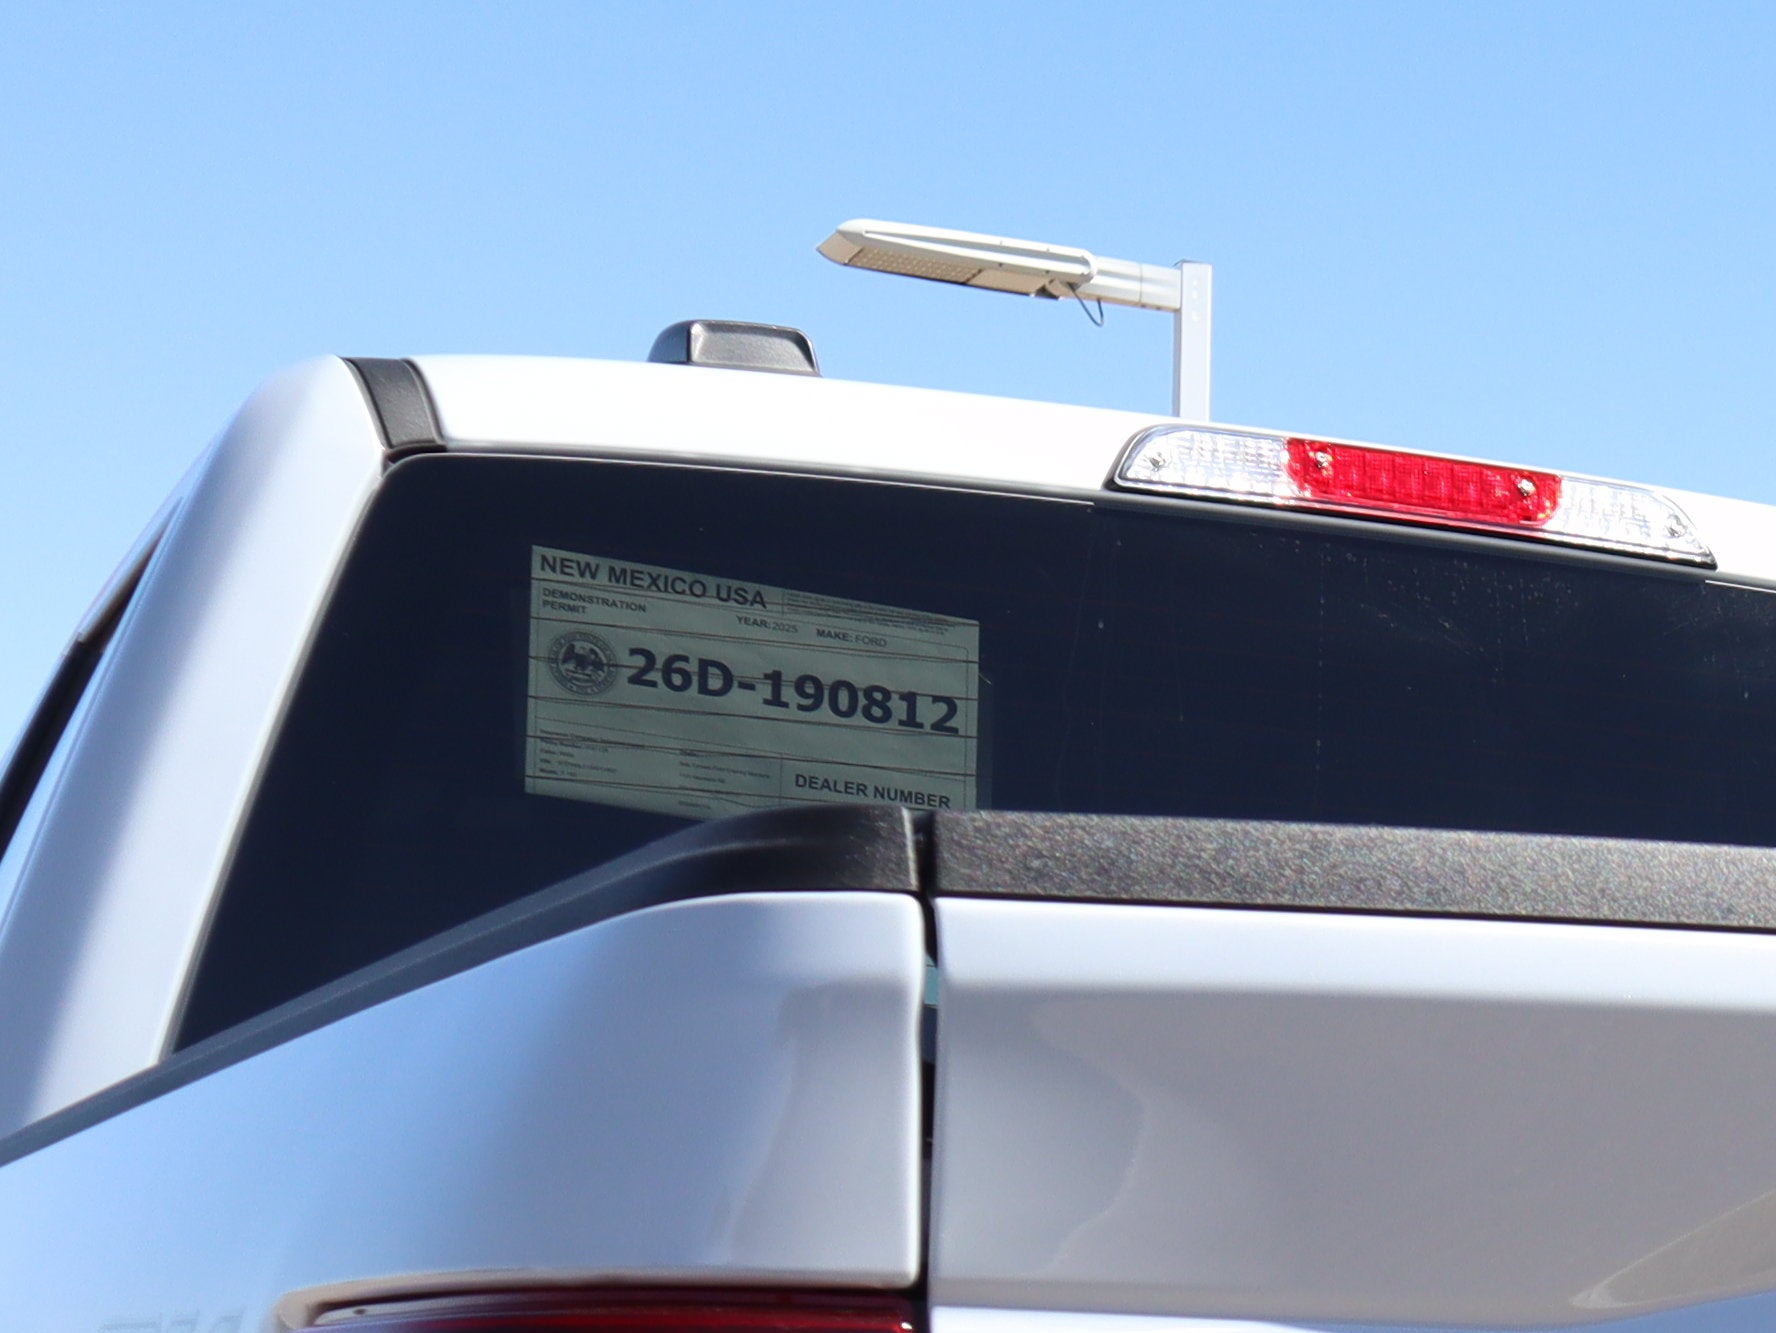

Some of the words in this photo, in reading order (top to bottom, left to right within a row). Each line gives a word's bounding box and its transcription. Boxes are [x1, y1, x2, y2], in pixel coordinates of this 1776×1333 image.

[539, 553, 600, 581] NEW
[607, 565, 708, 599] MEXICO
[716, 582, 768, 610] USA
[542, 587, 647, 613] DEMONSTRATION
[542, 600, 588, 616] PERMIT
[736, 614, 771, 631] YEAR:
[771, 621, 799, 635] 2025
[816, 627, 853, 645] MAKE:
[854, 633, 888, 649] FORD
[626, 646, 961, 736] 26D-190812
[794, 773, 869, 799] DEALER
[873, 785, 952, 810] NUMBER
